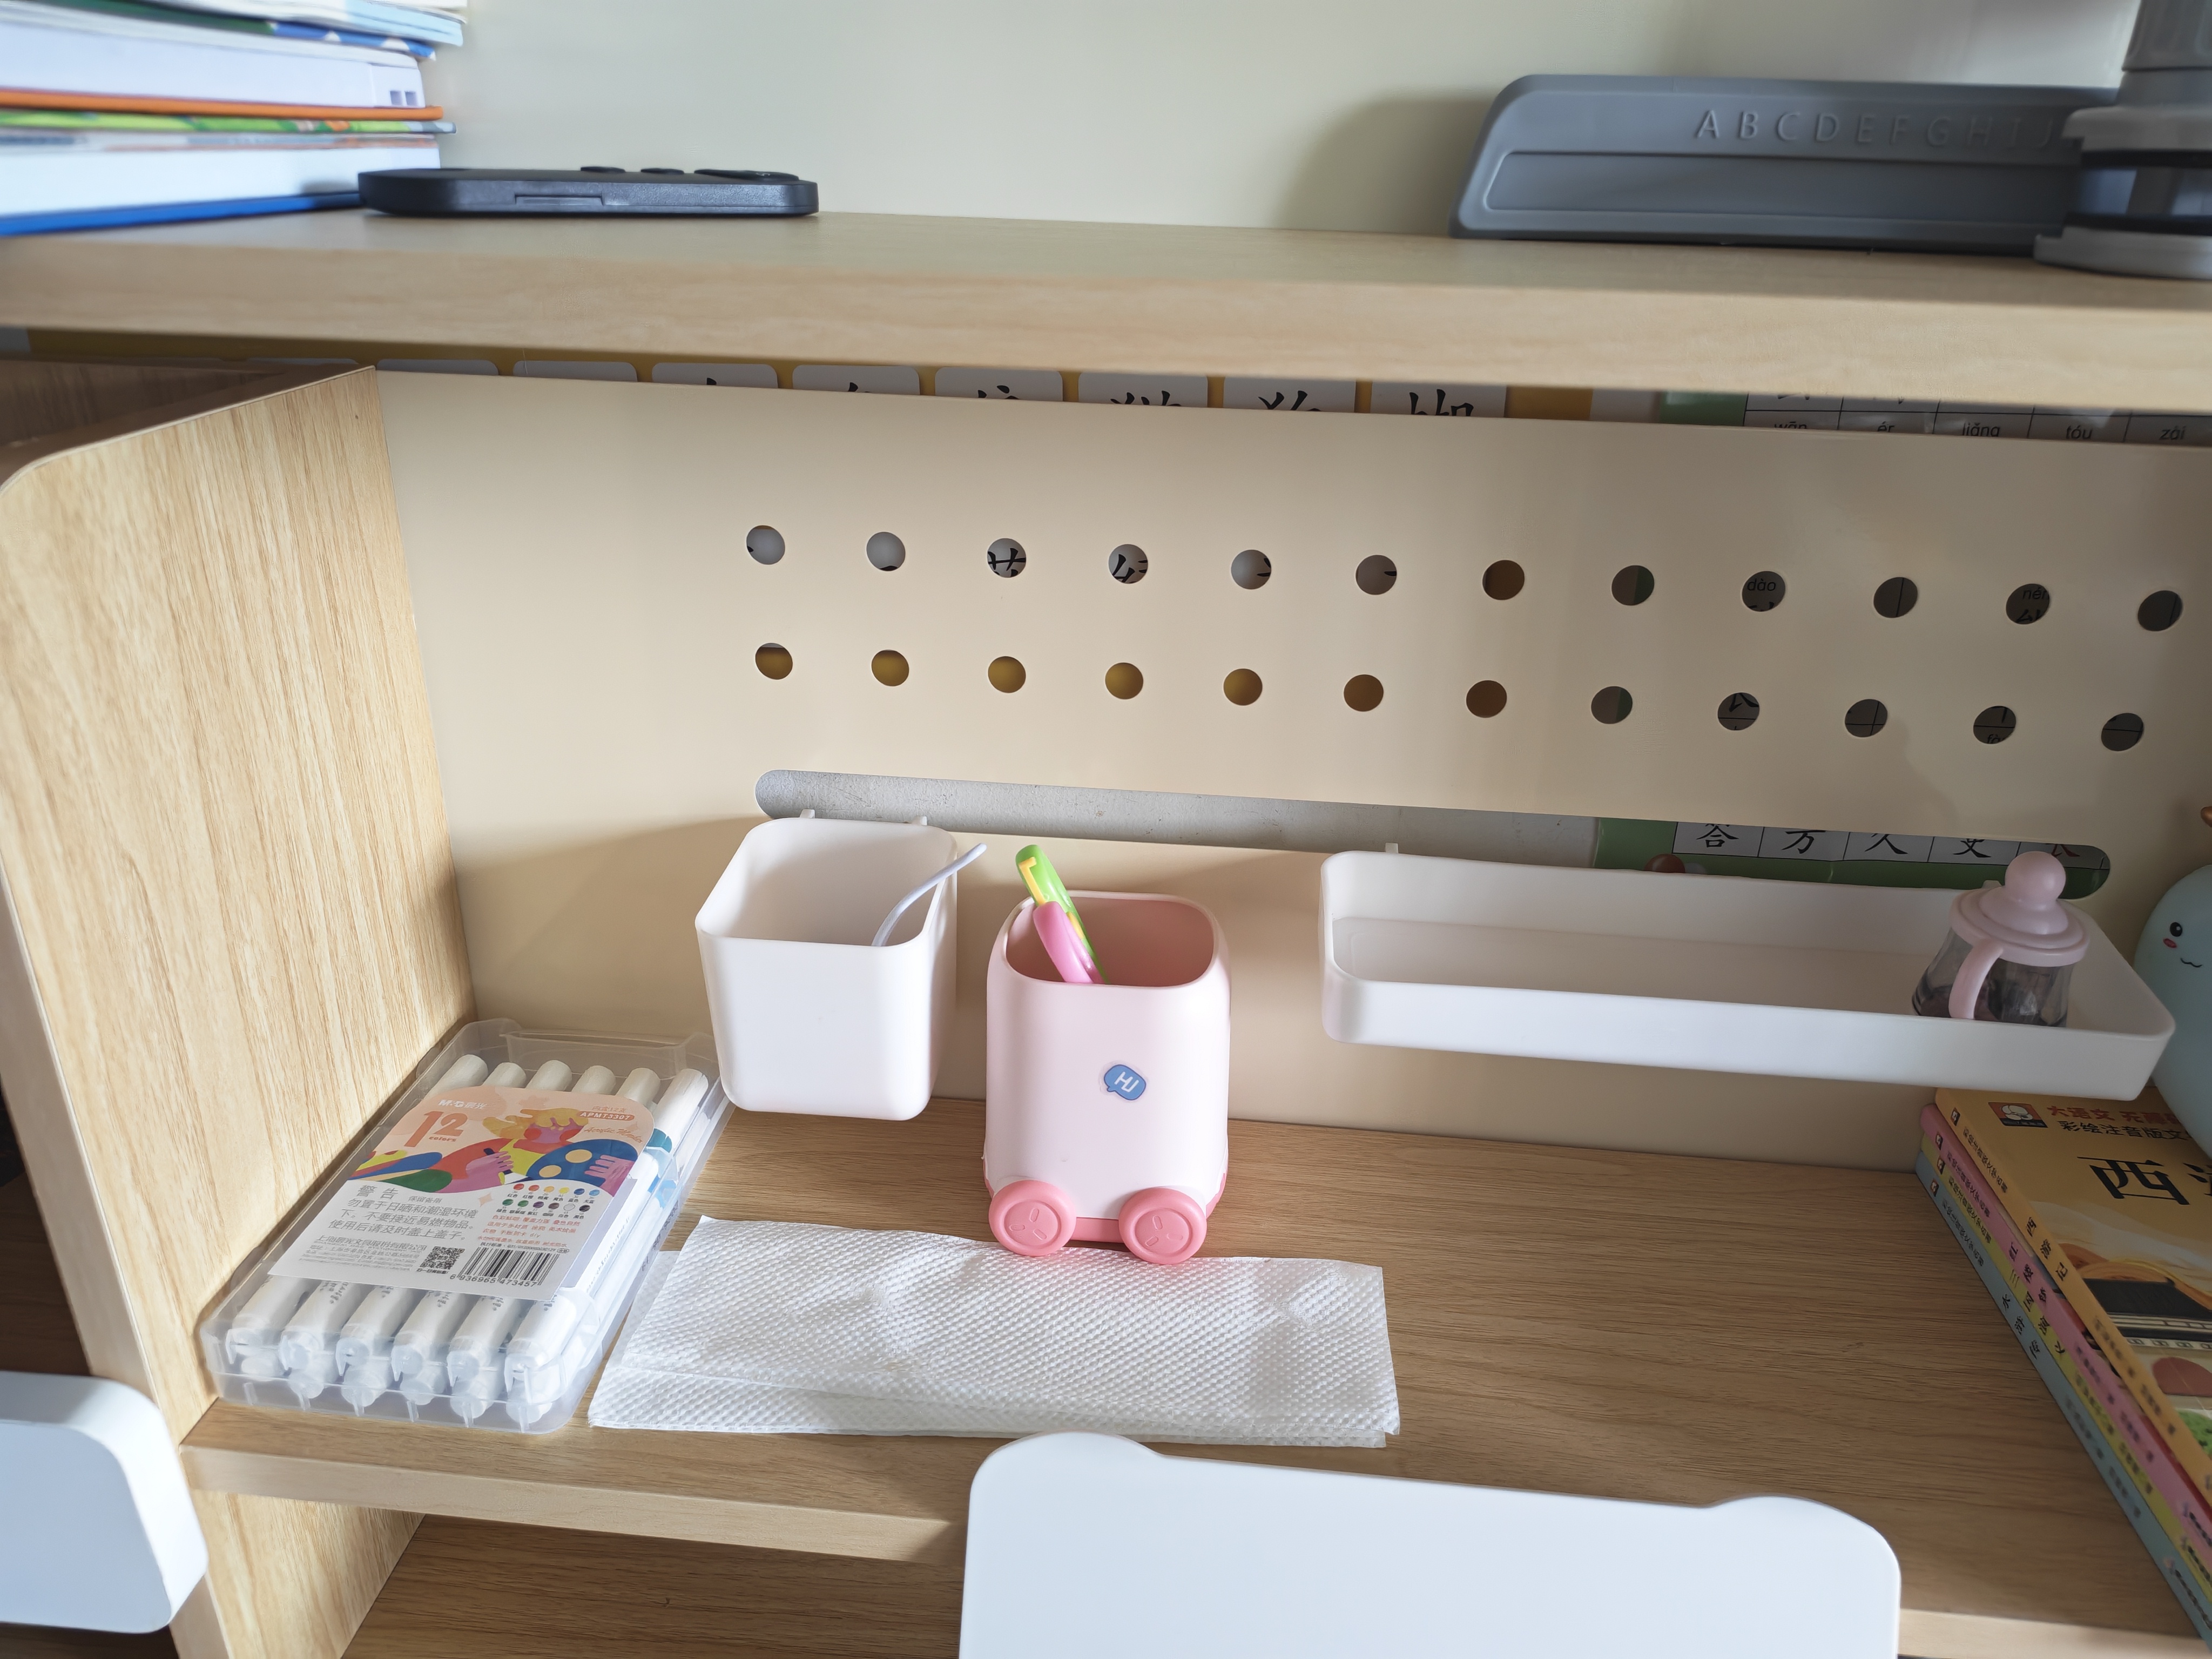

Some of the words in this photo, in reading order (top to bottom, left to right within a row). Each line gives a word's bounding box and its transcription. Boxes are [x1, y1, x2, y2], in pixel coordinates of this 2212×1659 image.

[2066, 424, 2094, 440] tóu
[1747, 578, 1776, 591] dào
[580, 1112, 631, 1120] APMT3307
[404, 1111, 468, 1147] 12
[2056, 1120, 2190, 1141] 彩绘注音版文
[347, 1198, 479, 1219] 勿置于日晒和潮湿环境
[2026, 1216, 2068, 1282] 西游记
[460, 1275, 496, 1283] 936965
[500, 1278, 537, 1287] 473457
